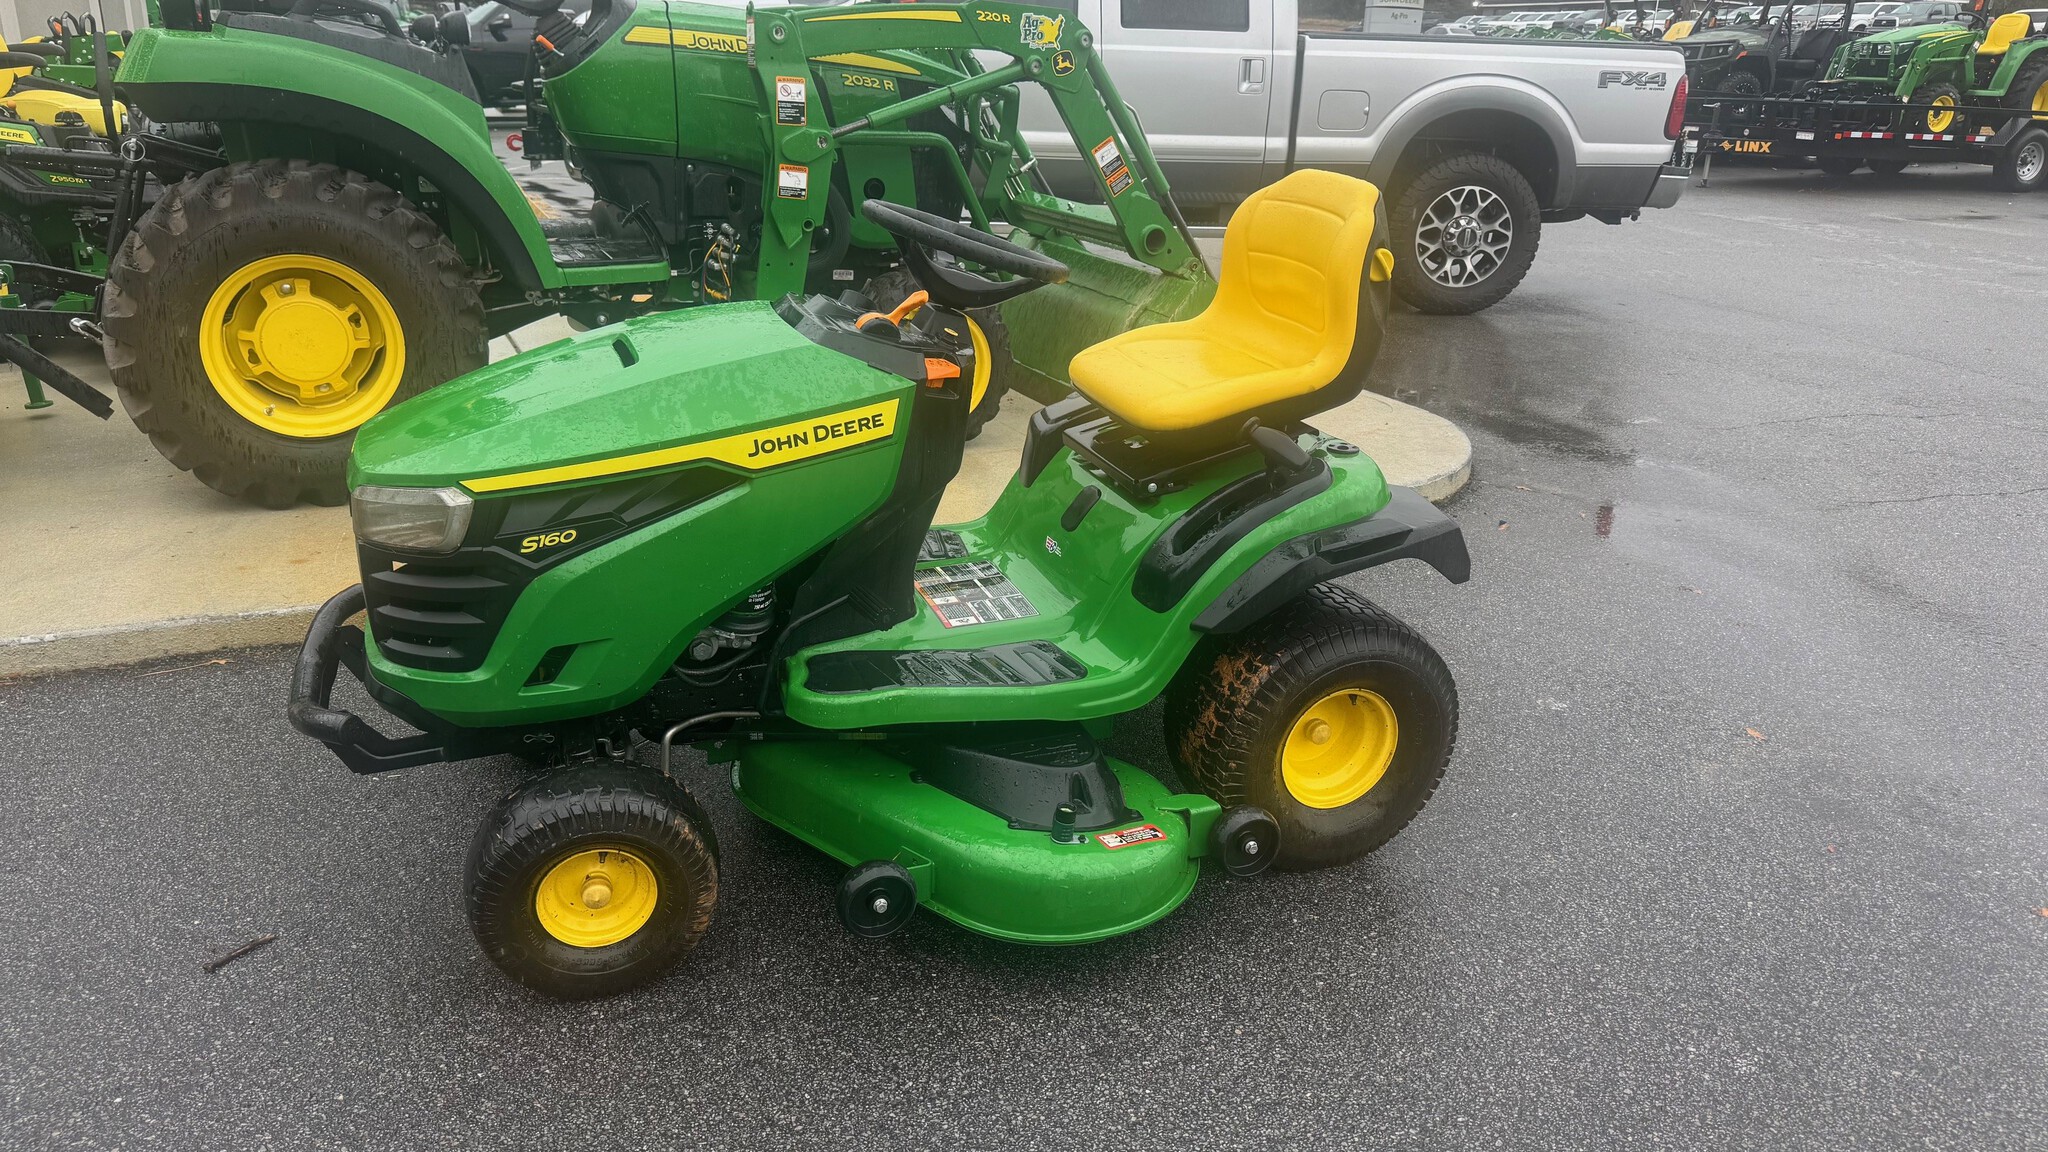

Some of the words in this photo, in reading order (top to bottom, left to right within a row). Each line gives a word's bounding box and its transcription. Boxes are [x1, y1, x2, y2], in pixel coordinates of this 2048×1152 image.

[976, 10, 1001, 22] 220
[1001, 14, 1012, 24] R
[1023, 15, 1044, 31] Ag-
[688, 33, 733, 51] JOHN
[1024, 29, 1044, 41] Pro
[841, 73, 881, 89] 2032
[883, 79, 895, 92] R
[1598, 70, 1666, 88] FX4
[1734, 140, 1772, 153] LINX
[747, 431, 809, 458] JOHN
[812, 413, 885, 443] DEERE
[520, 529, 577, 554] S160
